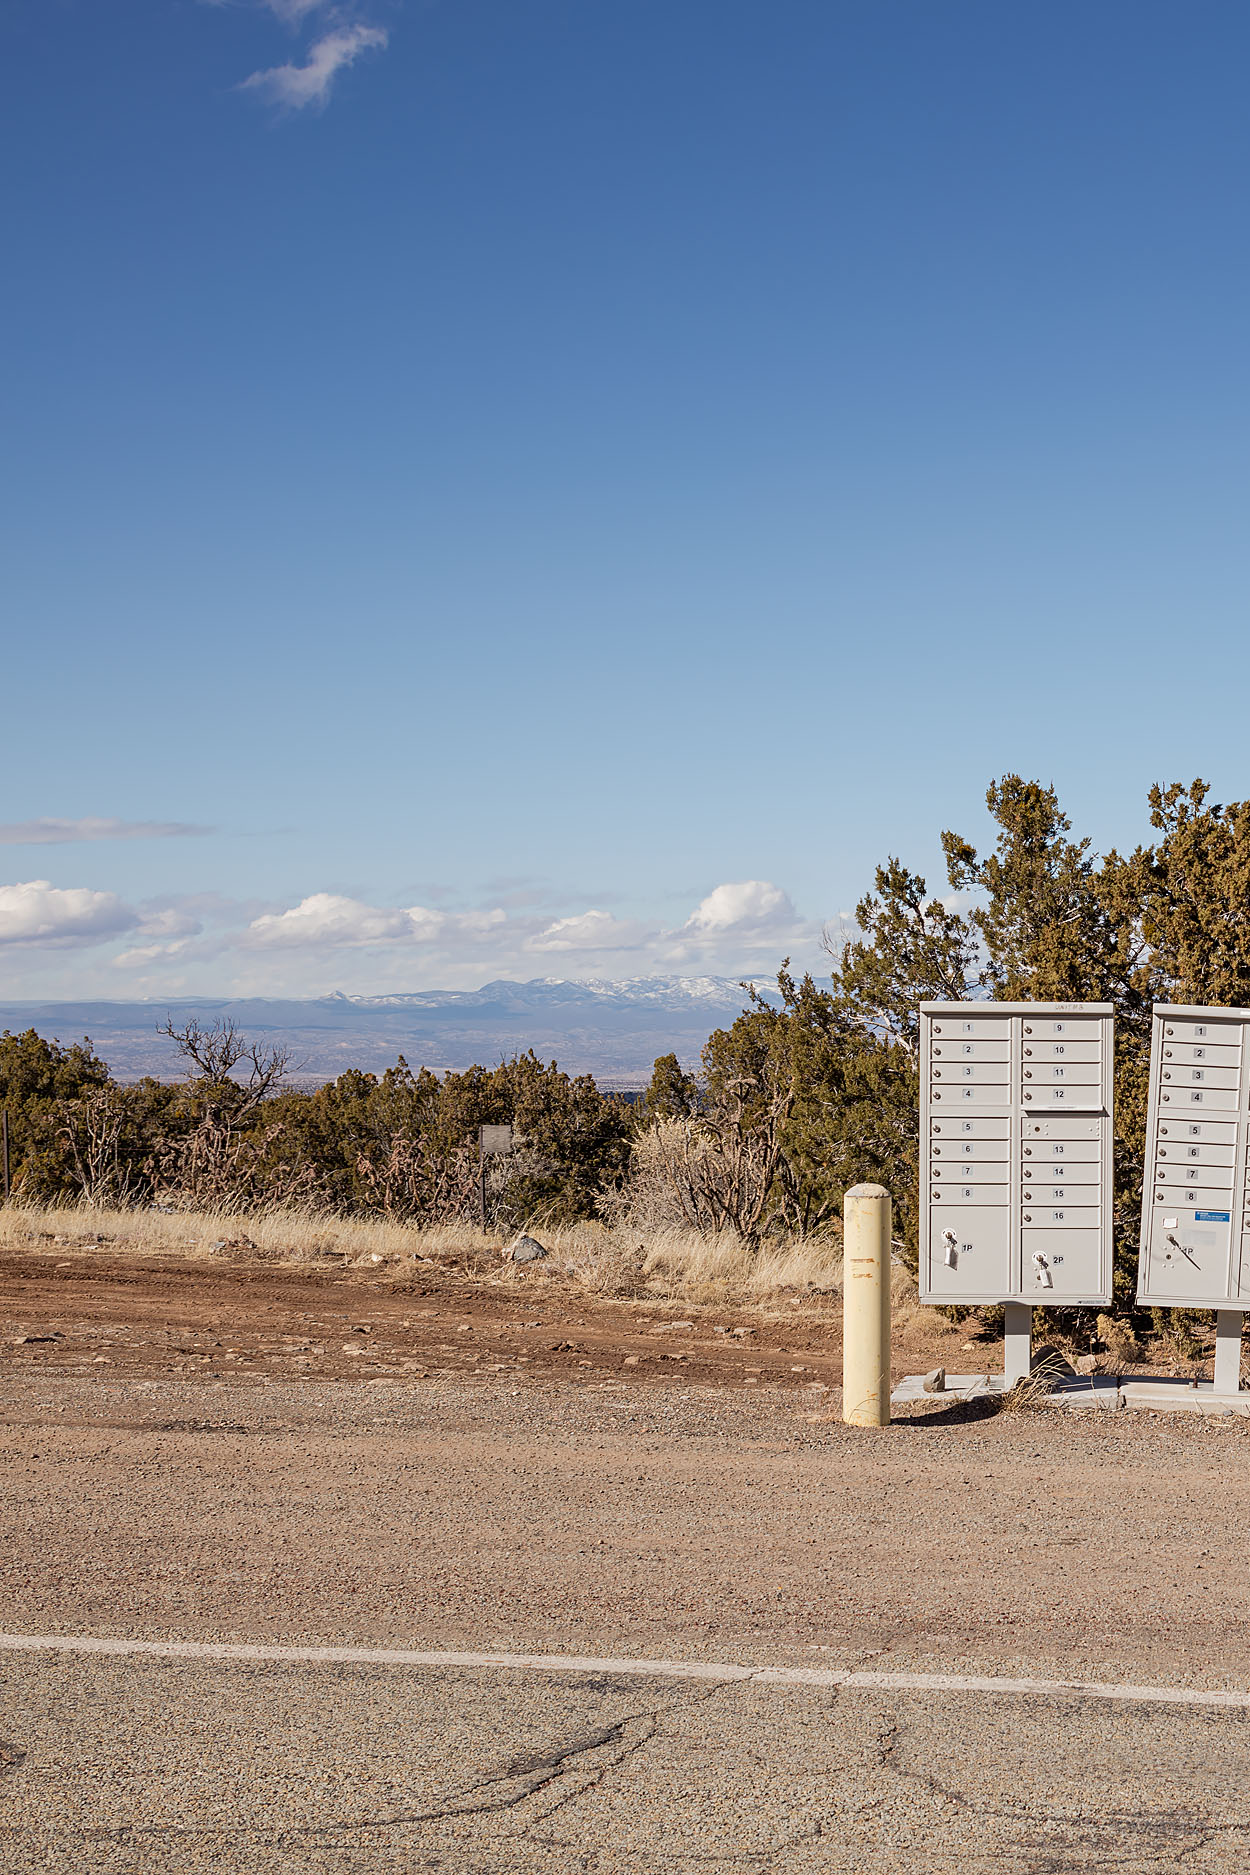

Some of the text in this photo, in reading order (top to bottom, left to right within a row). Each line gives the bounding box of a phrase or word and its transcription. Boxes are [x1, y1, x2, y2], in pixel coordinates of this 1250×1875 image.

[1196, 1049, 1202, 1057] 2
[965, 1067, 970, 1075] 3
[1196, 1071, 1201, 1079] 3
[1193, 1126, 1198, 1134] 5
[1191, 1148, 1196, 1156] 6
[1189, 1192, 1194, 1200] 8
